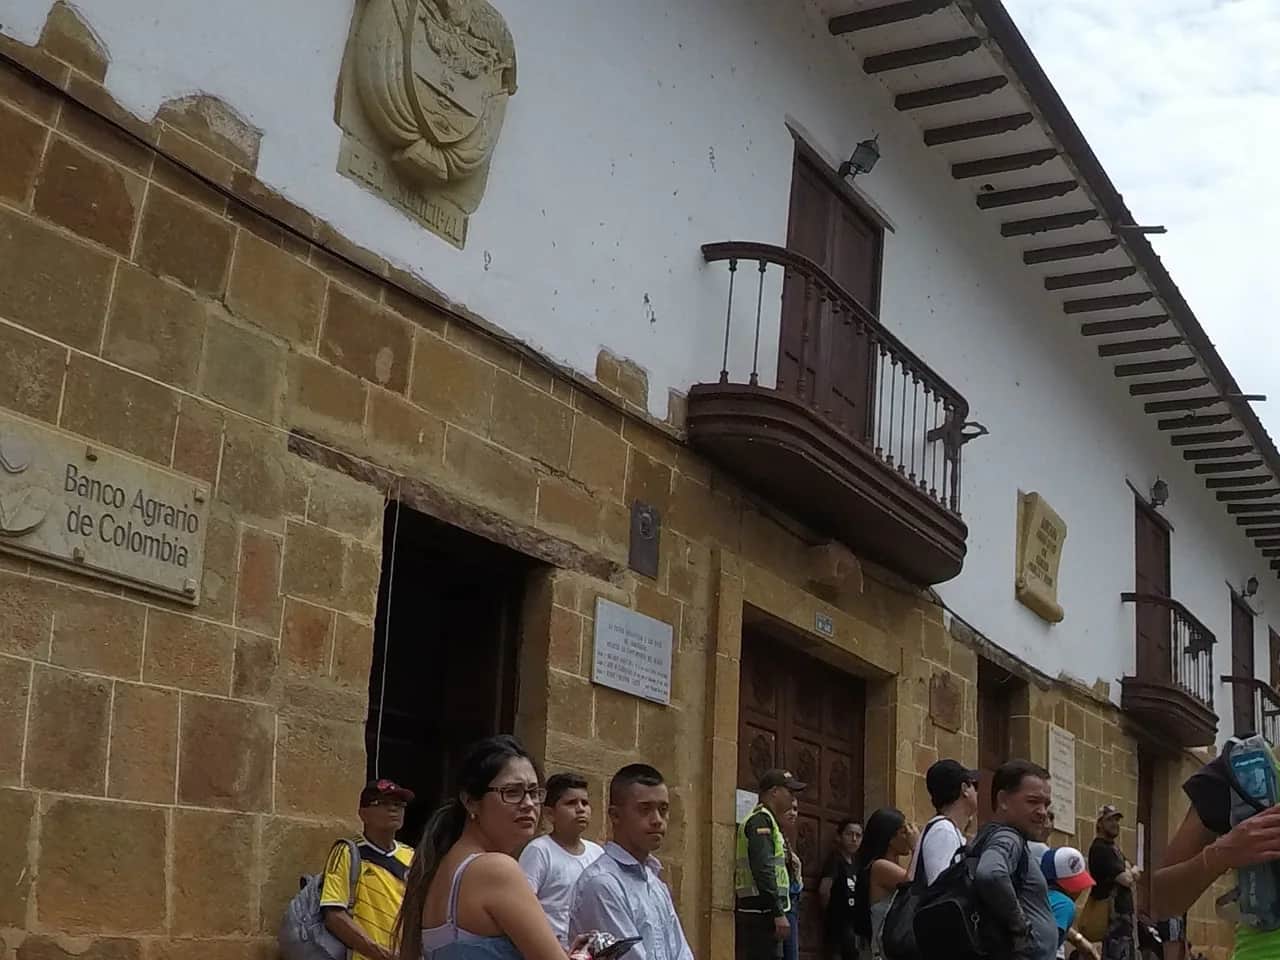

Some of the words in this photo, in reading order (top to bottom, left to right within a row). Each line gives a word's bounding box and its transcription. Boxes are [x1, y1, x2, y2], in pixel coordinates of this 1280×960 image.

[64, 463, 125, 509] Banco
[132, 488, 199, 533] Agrario
[67, 504, 94, 537] de
[99, 513, 188, 568] Colombia
